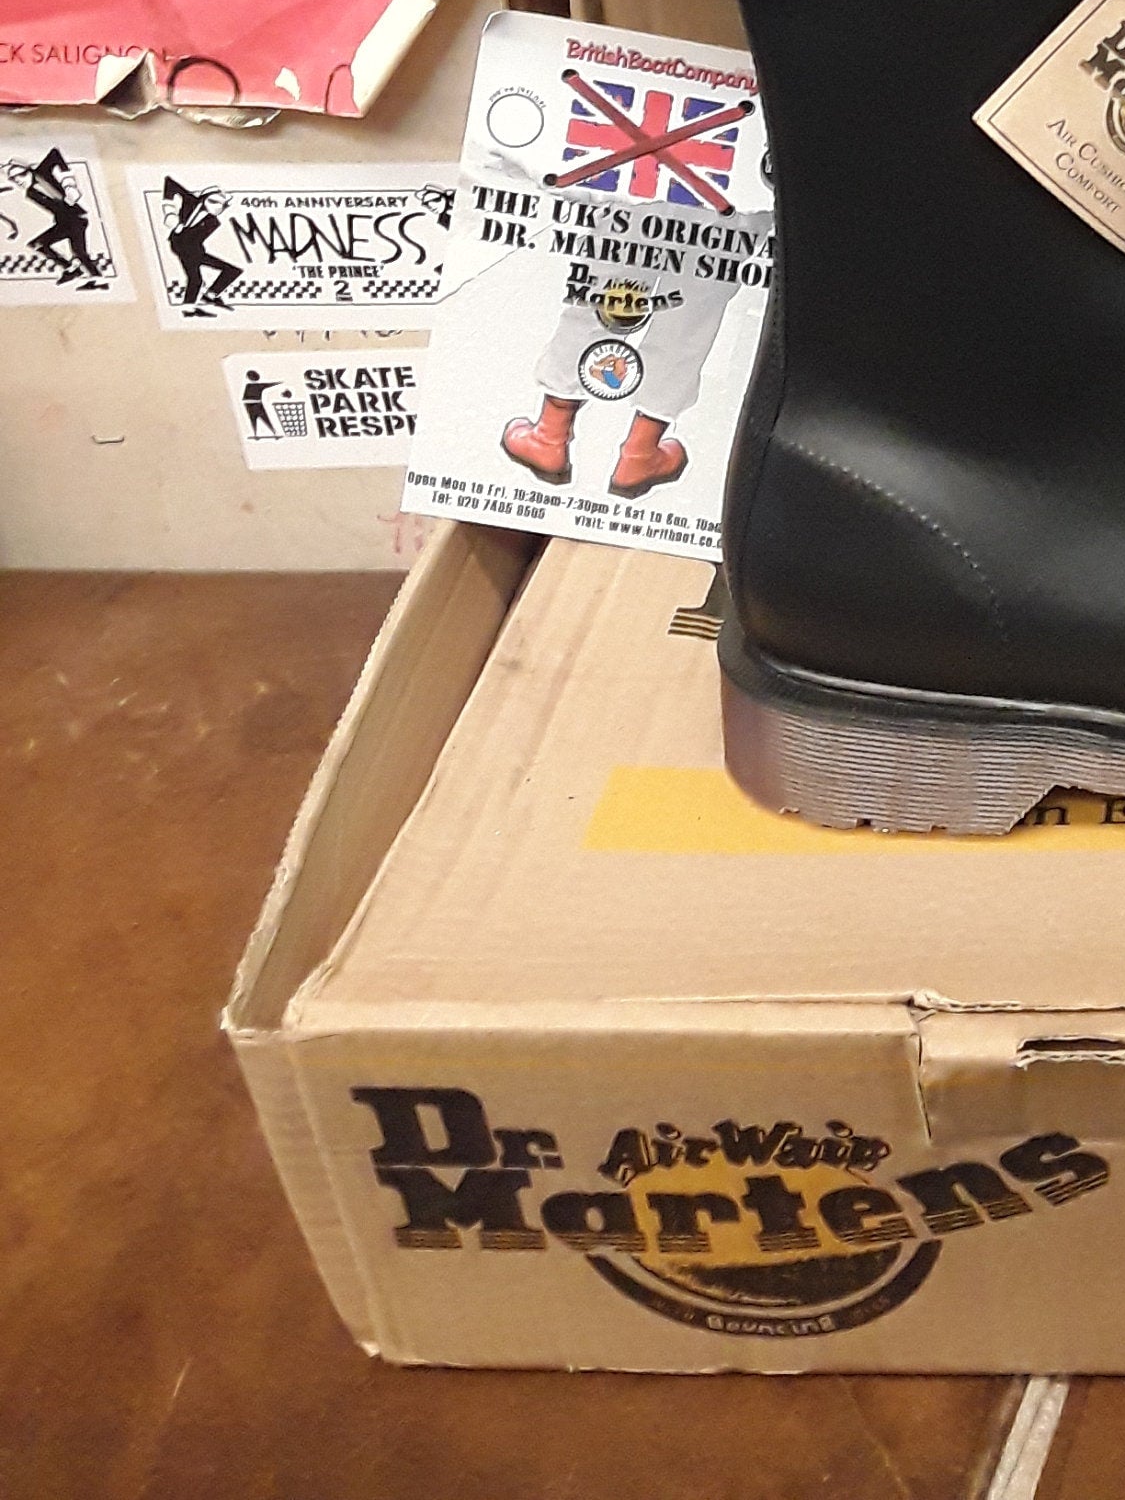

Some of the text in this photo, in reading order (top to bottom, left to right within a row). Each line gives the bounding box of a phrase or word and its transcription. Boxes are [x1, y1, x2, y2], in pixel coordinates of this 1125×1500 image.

[240, 196, 409, 209] 40th ANNIVERSARY
[472, 185, 541, 220] THE
[552, 200, 631, 235] UK'S
[229, 212, 427, 265] MADNESS
[480, 217, 536, 250] DR.
[549, 229, 686, 274] MARTEN
[333, 280, 354, 299] 2
[562, 283, 685, 313] Martens
[303, 366, 417, 391] SKATE
[308, 390, 408, 415] PARK
[406, 471, 438, 488] Open
[440, 476, 467, 493] Mon
[624, 505, 647, 521] Sat
[349, 1086, 892, 1188] Dr. AirWair
[376, 1132, 1110, 1253] Martens
